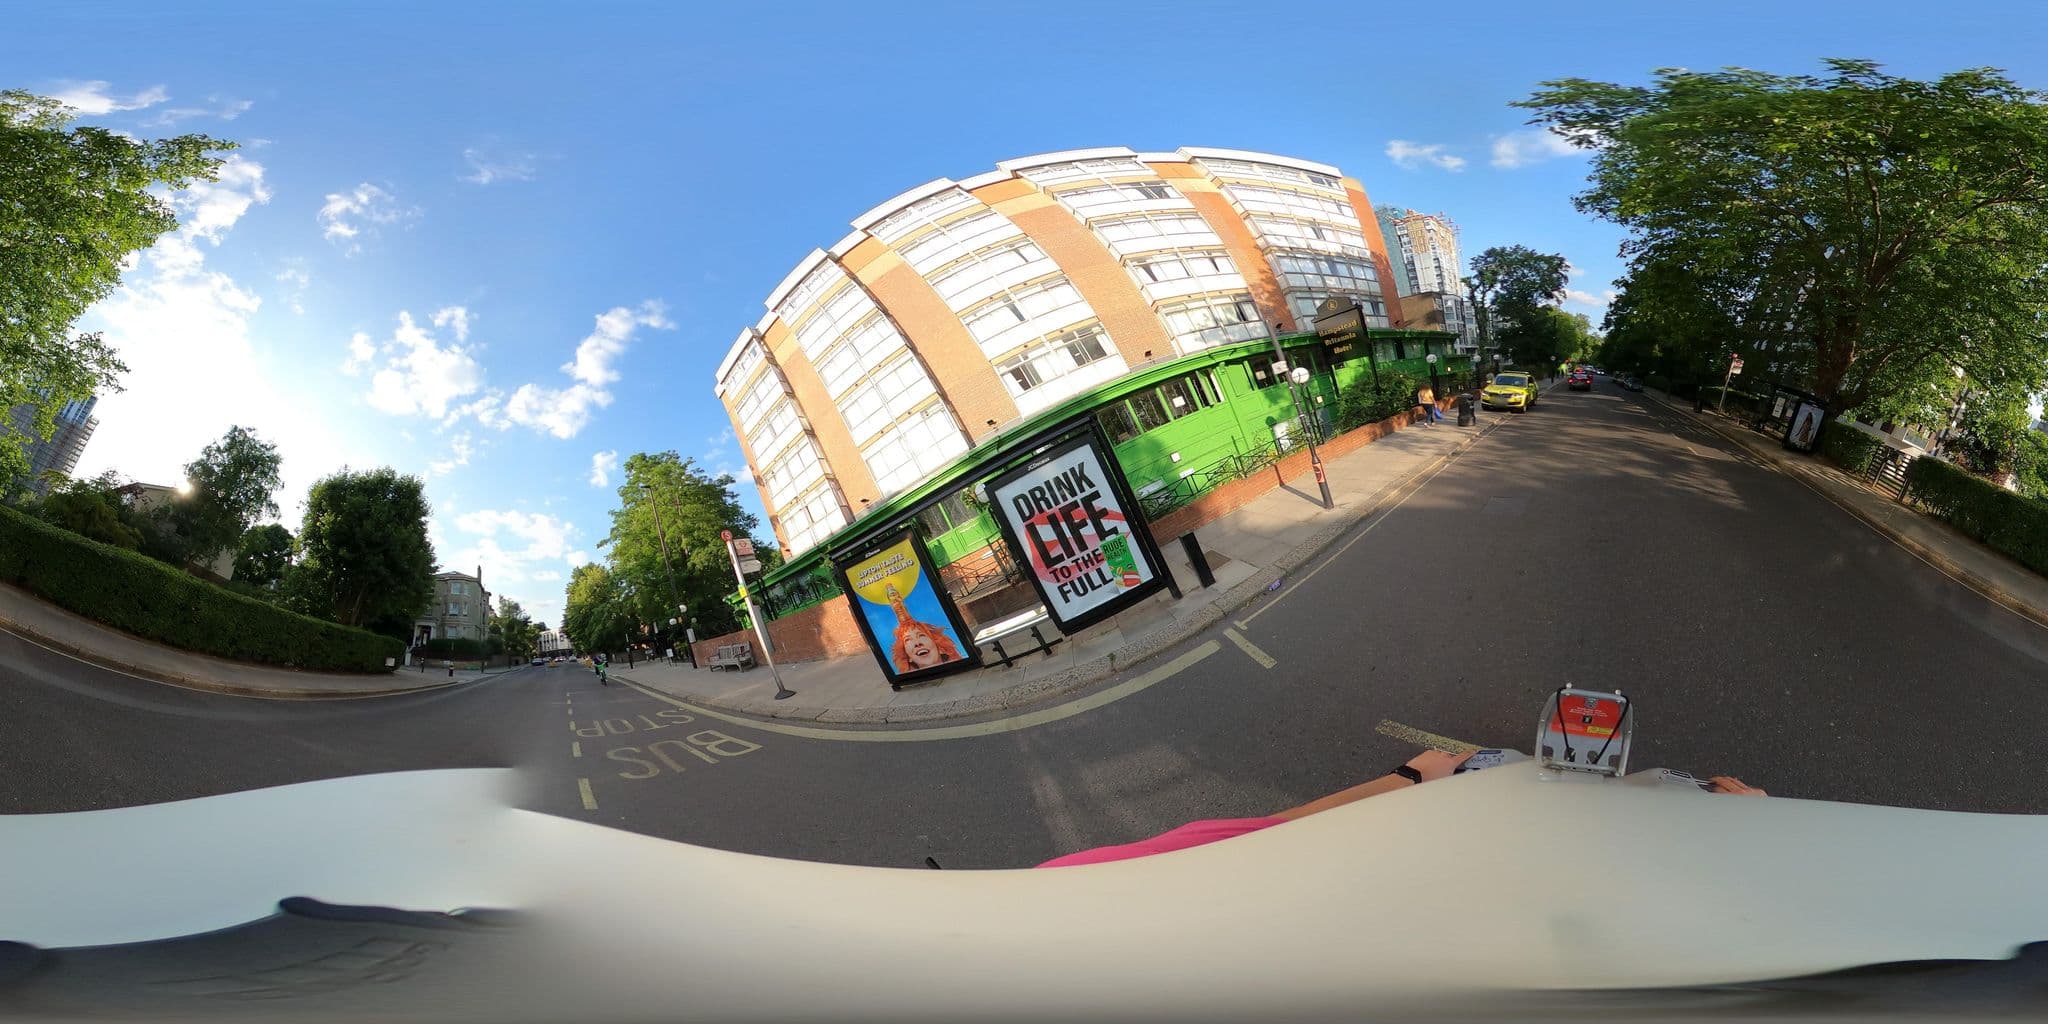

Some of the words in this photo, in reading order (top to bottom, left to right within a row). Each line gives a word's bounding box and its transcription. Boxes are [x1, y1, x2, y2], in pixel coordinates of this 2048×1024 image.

[1012, 461, 1096, 524] DRINK
[1025, 490, 1119, 570] LIFE
[1103, 537, 1125, 555] RUDE
[884, 558, 914, 577] FEELING
[1049, 565, 1072, 584] TO
[1071, 548, 1105, 573] THE
[1057, 567, 1114, 604] FULL
[576, 709, 696, 738] STOP
[606, 729, 764, 779] BUS
